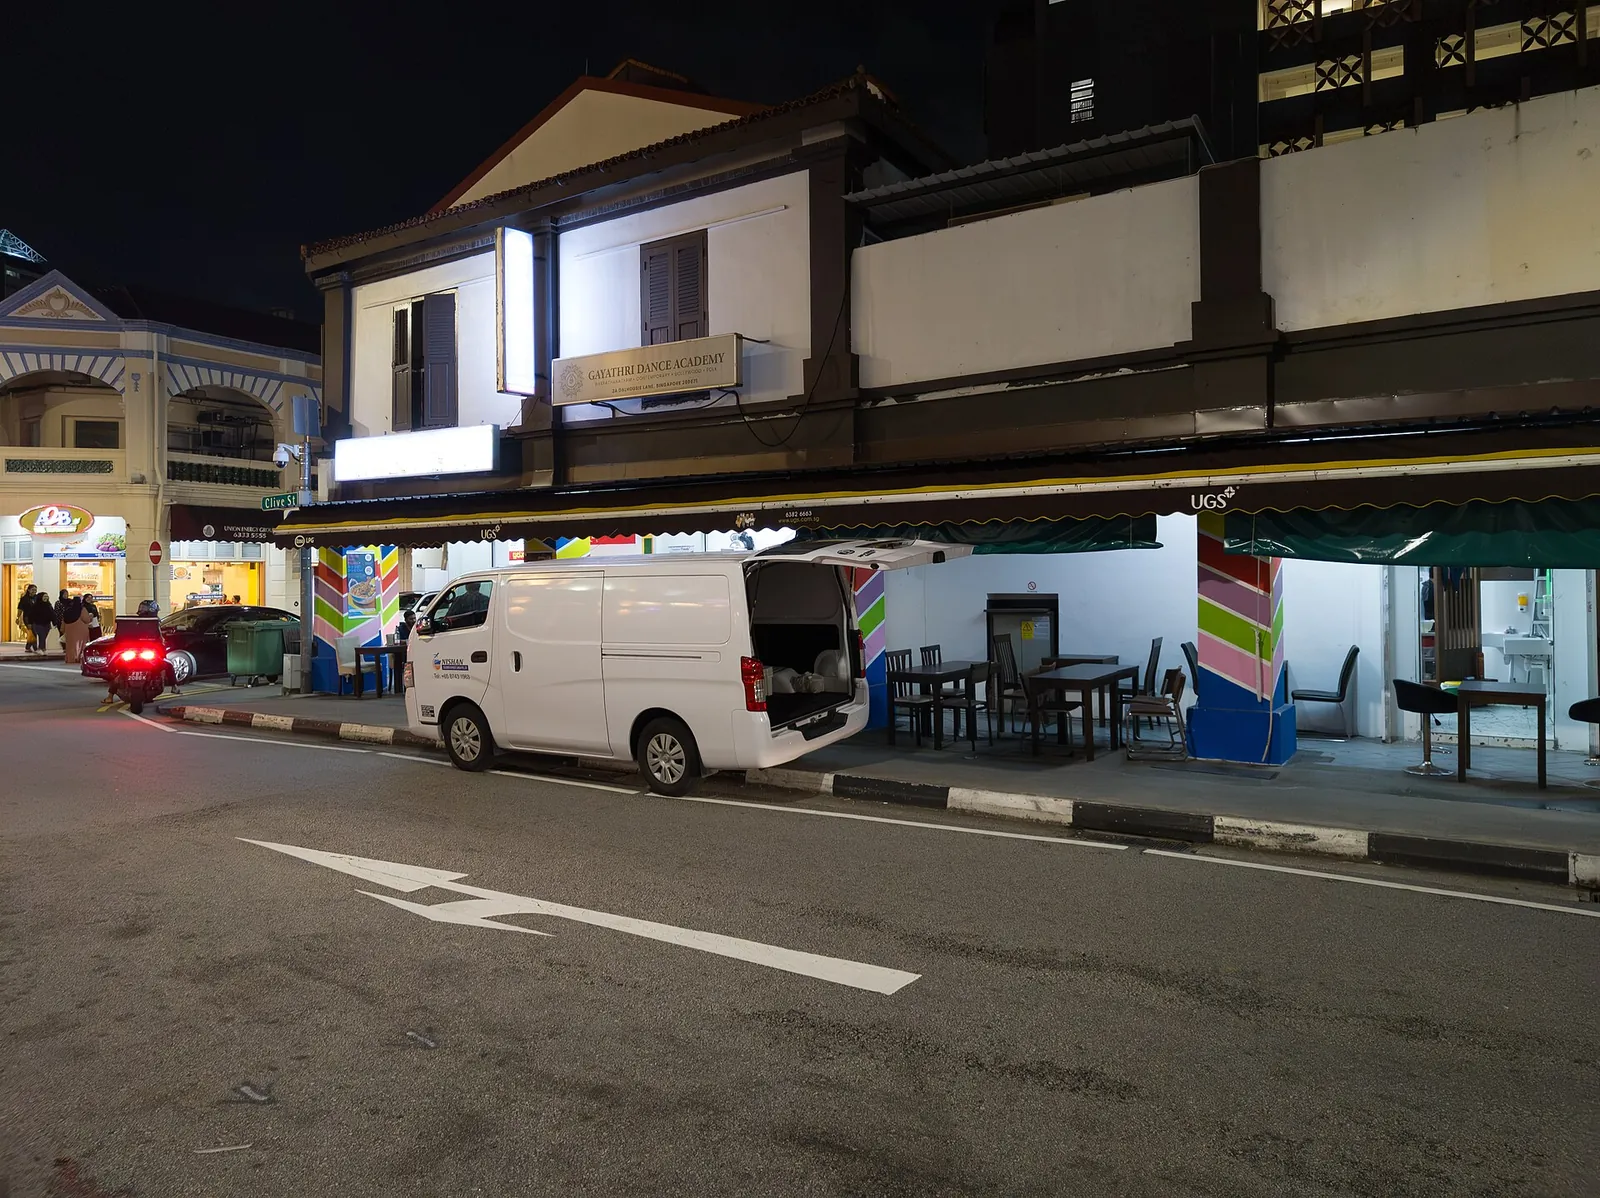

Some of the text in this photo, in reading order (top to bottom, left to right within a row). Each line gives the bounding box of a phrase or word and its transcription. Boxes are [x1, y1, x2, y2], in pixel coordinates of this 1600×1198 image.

[588, 352, 725, 380] GAYATHRI DANCE ACADEMY
[265, 495, 296, 509] Clive St
[1191, 493, 1227, 509] UGS
[480, 529, 497, 540] UGS
